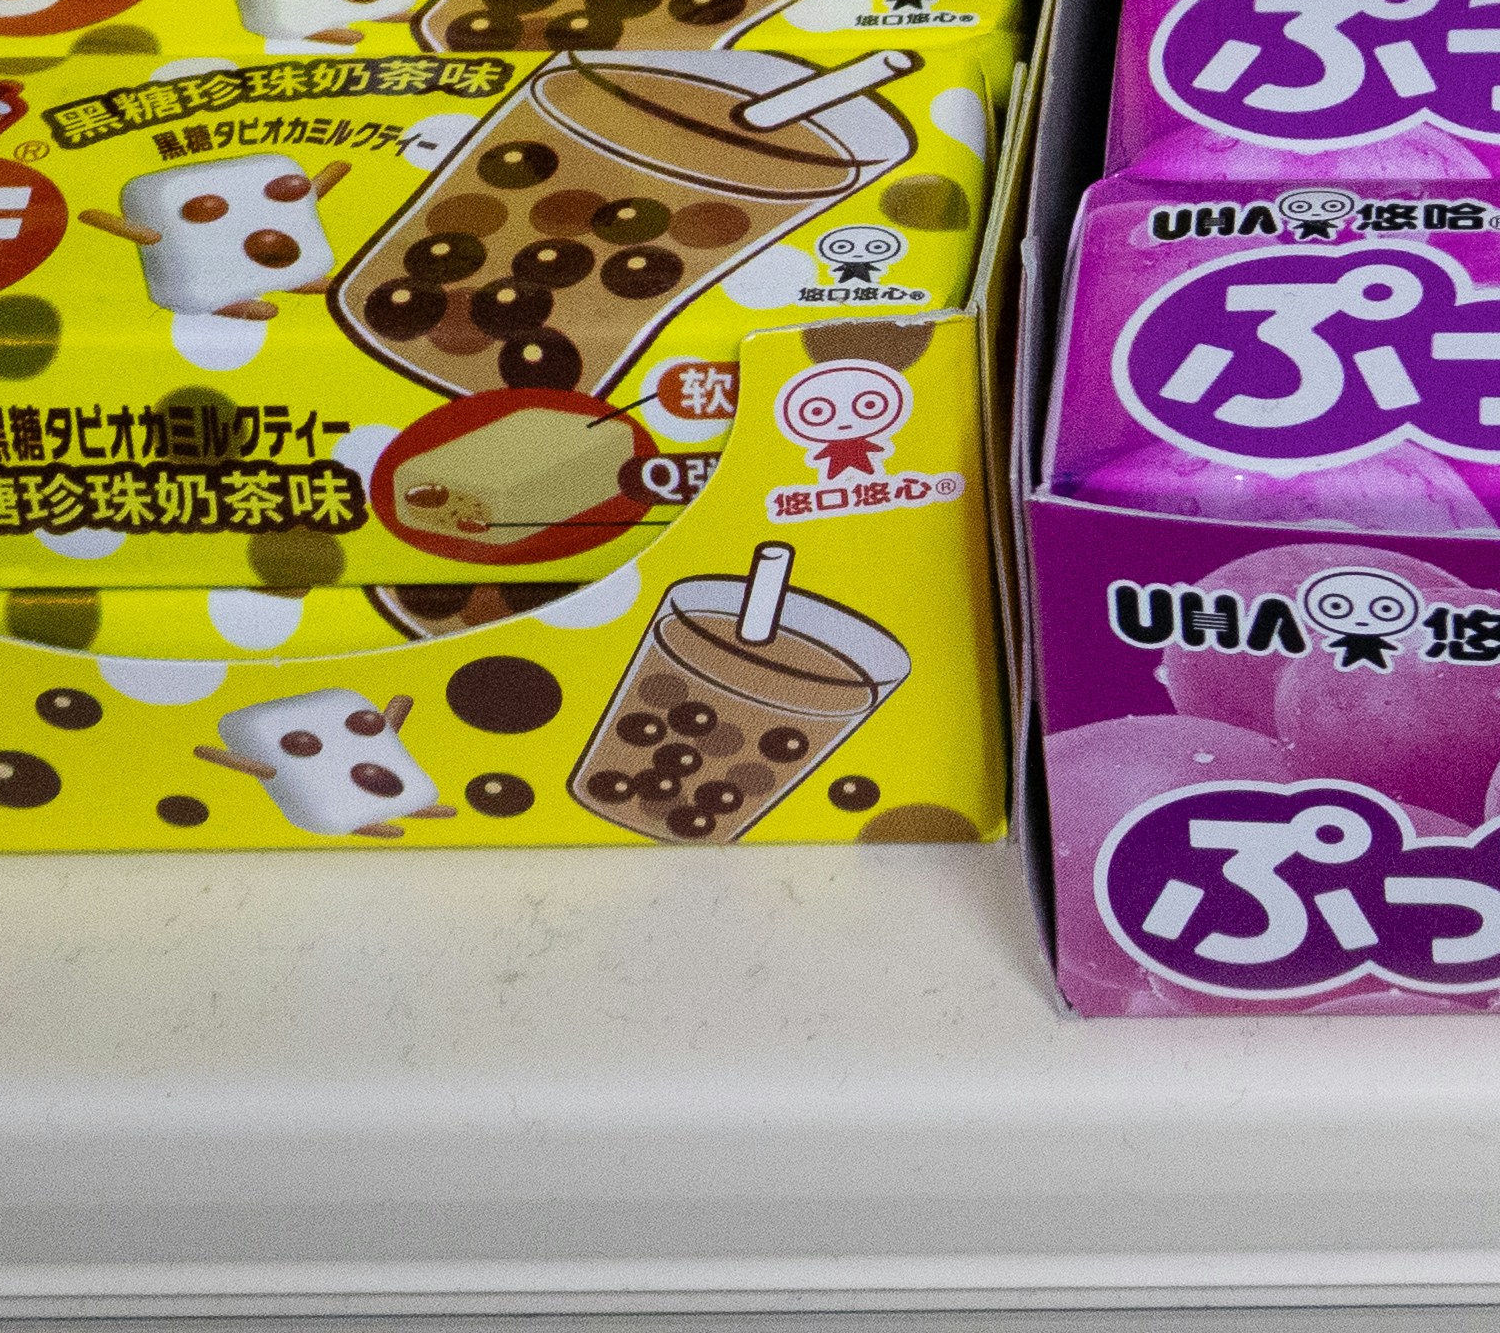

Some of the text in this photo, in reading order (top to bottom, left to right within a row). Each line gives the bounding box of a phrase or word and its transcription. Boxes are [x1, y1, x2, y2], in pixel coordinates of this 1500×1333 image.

[56, 60, 501, 140] 黑糖珍珠奶茶味
[155, 119, 440, 159] 黑糖タピオカミルクティー
[1154, 202, 1486, 239] UHA 悠哈
[799, 288, 907, 304] 悠口悠心
[774, 478, 932, 517] 悠口悠心
[1115, 587, 1305, 654] UHA
